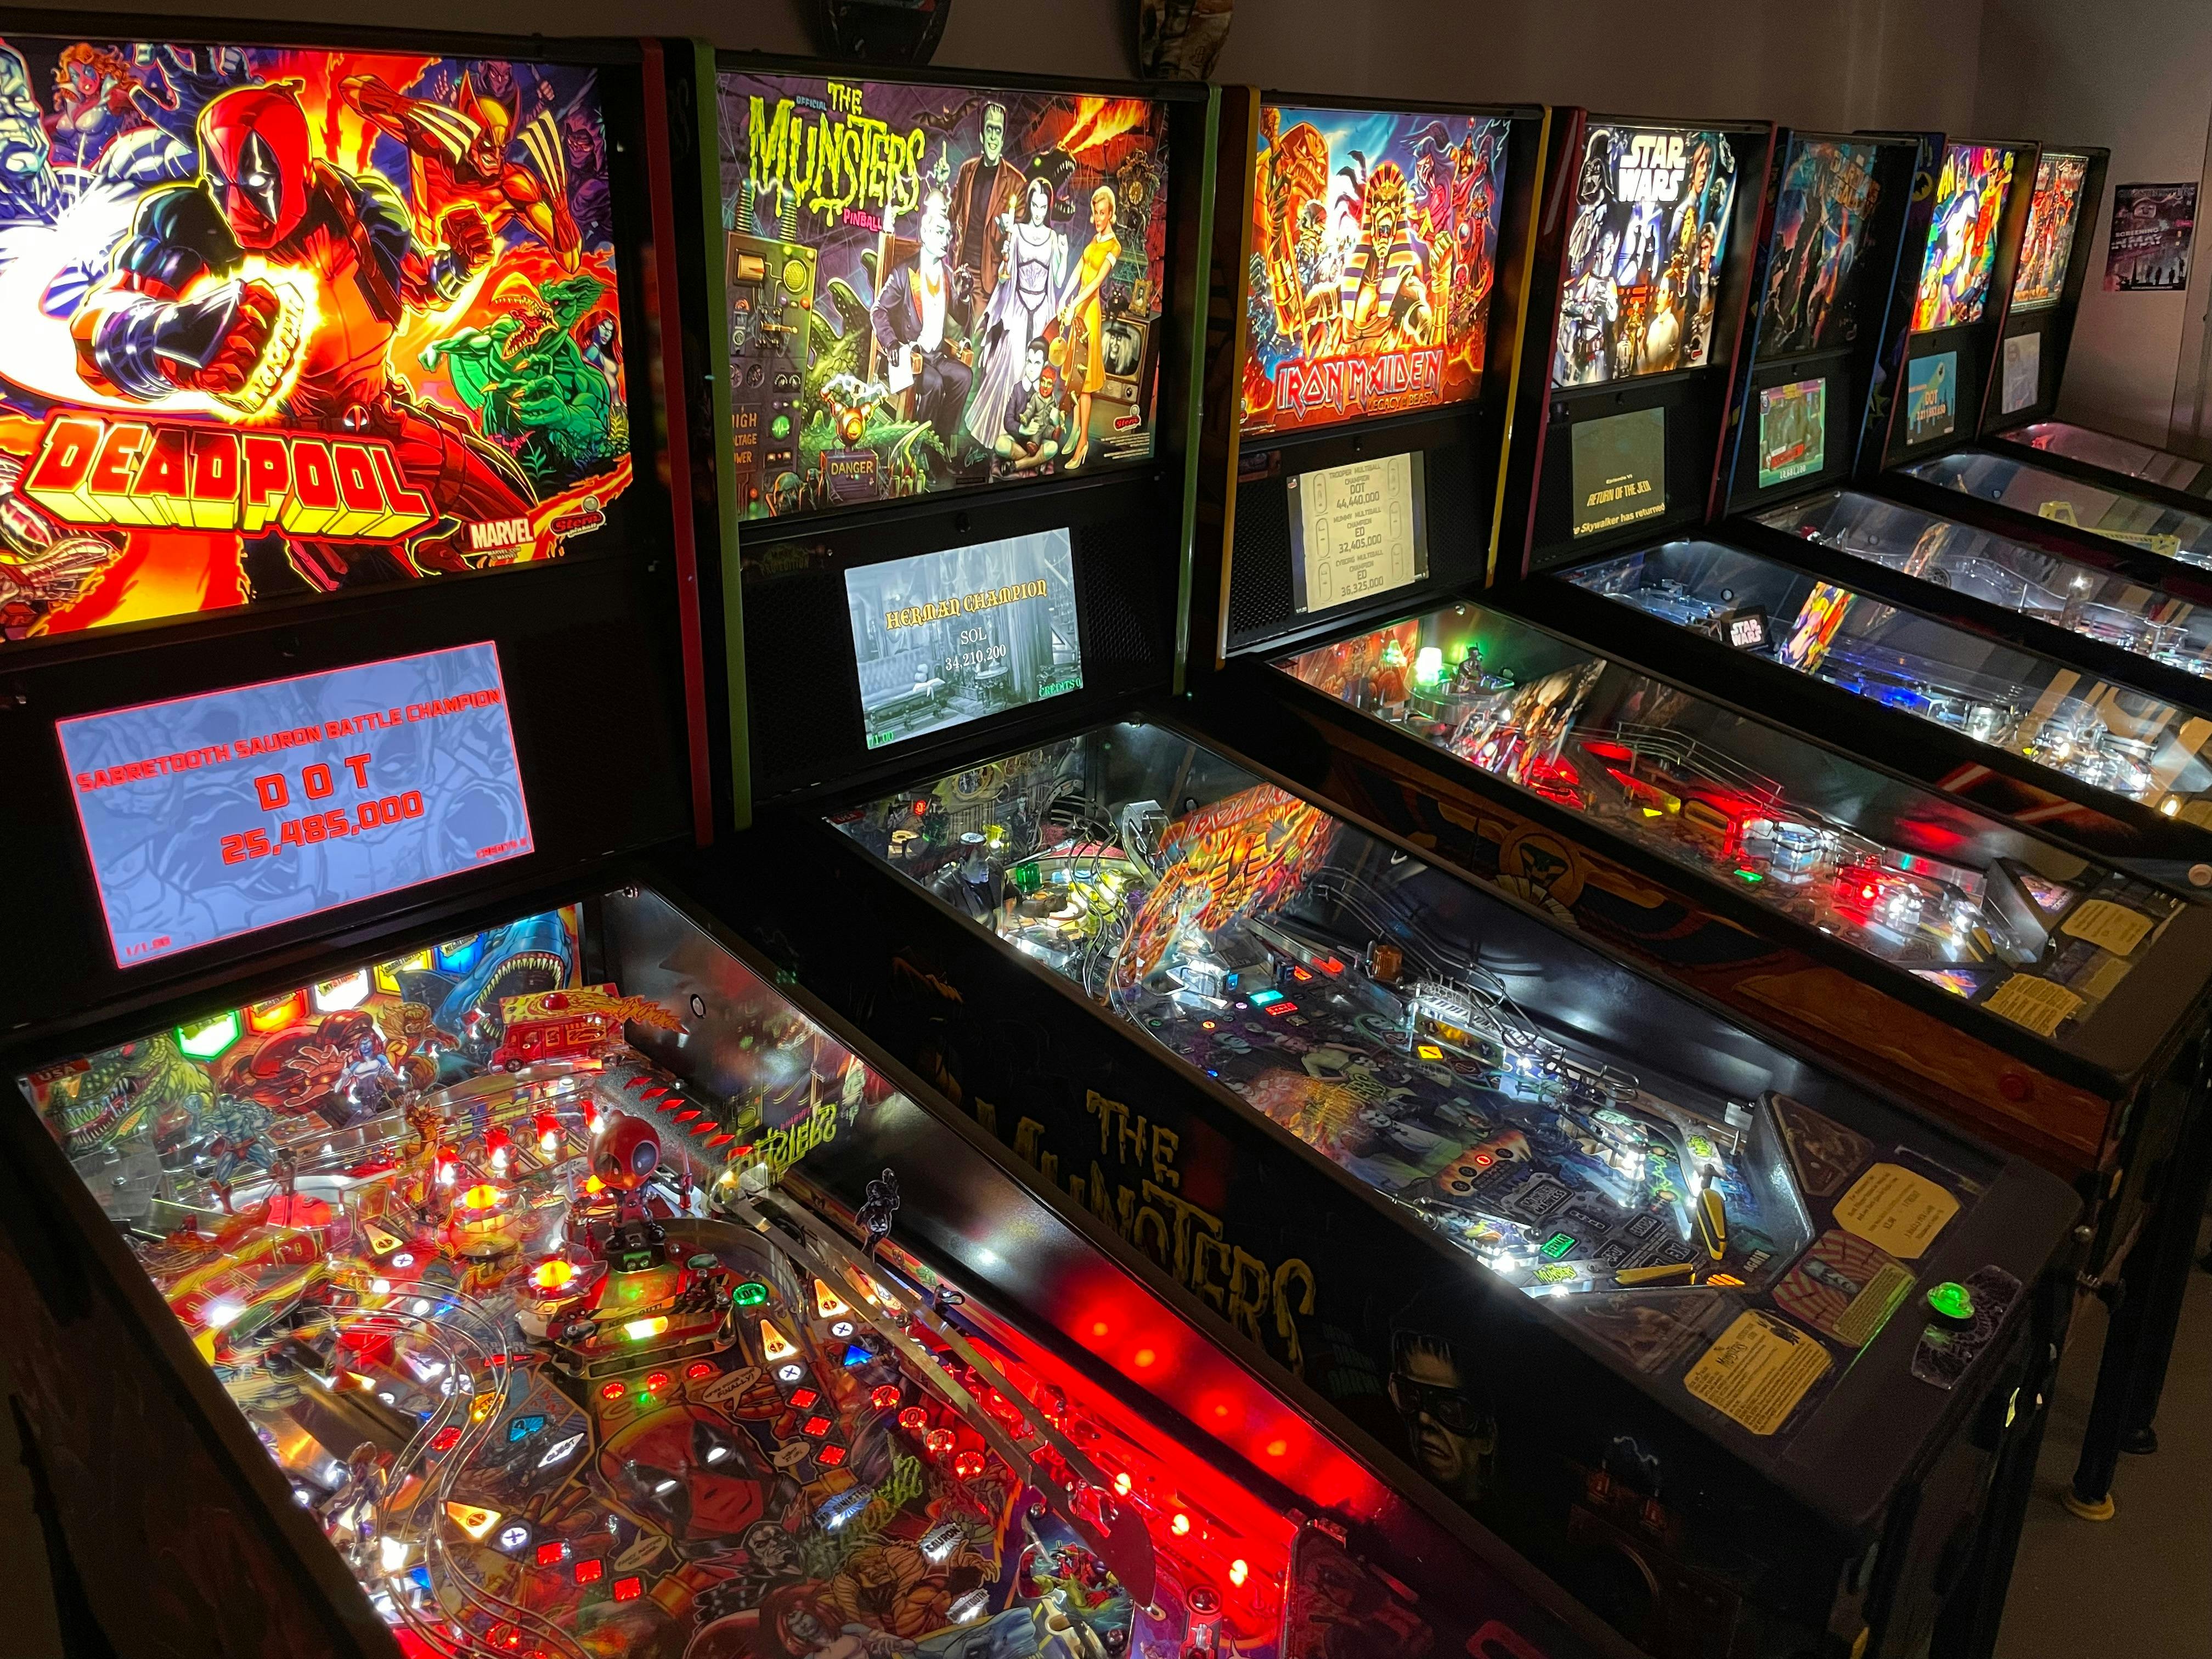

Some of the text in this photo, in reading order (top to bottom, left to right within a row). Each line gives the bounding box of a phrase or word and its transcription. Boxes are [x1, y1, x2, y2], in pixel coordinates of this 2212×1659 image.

[796, 95, 827, 111] OFFICIAL
[828, 82, 862, 115] THE
[749, 95, 926, 227] MUNSTERS
[1620, 135, 1686, 169] STAR
[1618, 168, 1685, 202] WARS
[843, 208, 883, 232] PINBALL
[1277, 362, 1344, 419] IRON
[1348, 349, 1443, 412] MAIDEN
[1368, 397, 1400, 412] LEGACY
[1408, 391, 1434, 407] BEAST
[733, 433, 758, 447] LTAGE
[25, 417, 432, 538] DEADPOOL
[831, 461, 874, 476] DANGER
[1350, 482, 1365, 495] DOT
[1587, 480, 1651, 507] RETURN OF THE JEDI
[555, 515, 602, 531] Stern
[1581, 516, 1619, 533] Skywalker
[1621, 512, 1634, 522] has
[1635, 502, 1665, 518] returned
[471, 518, 534, 549] MARVEL
[1355, 526, 1365, 537] ED
[1341, 575, 1384, 597] 36,325,000
[1357, 569, 1367, 580] ED
[885, 579, 1047, 631] HERMAN CHAMPION
[960, 627, 988, 645] SOL
[1730, 618, 1760, 634] STAR
[1731, 629, 1762, 647] WARS
[945, 644, 1007, 672] 34,210,200
[1039, 680, 1075, 698] CREDITS
[76, 688, 501, 793] SABRETOOTH SAURON BATTLE CHAMPION
[221, 788, 425, 866] 25,485,000
[38, 1066, 77, 1081] USA
[1086, 1088, 1180, 1188] THE
[1533, 1266, 1577, 1284] MUNSTERS
[832, 1485, 871, 1514] SINISTER
[926, 1526, 961, 1553] SAURON
